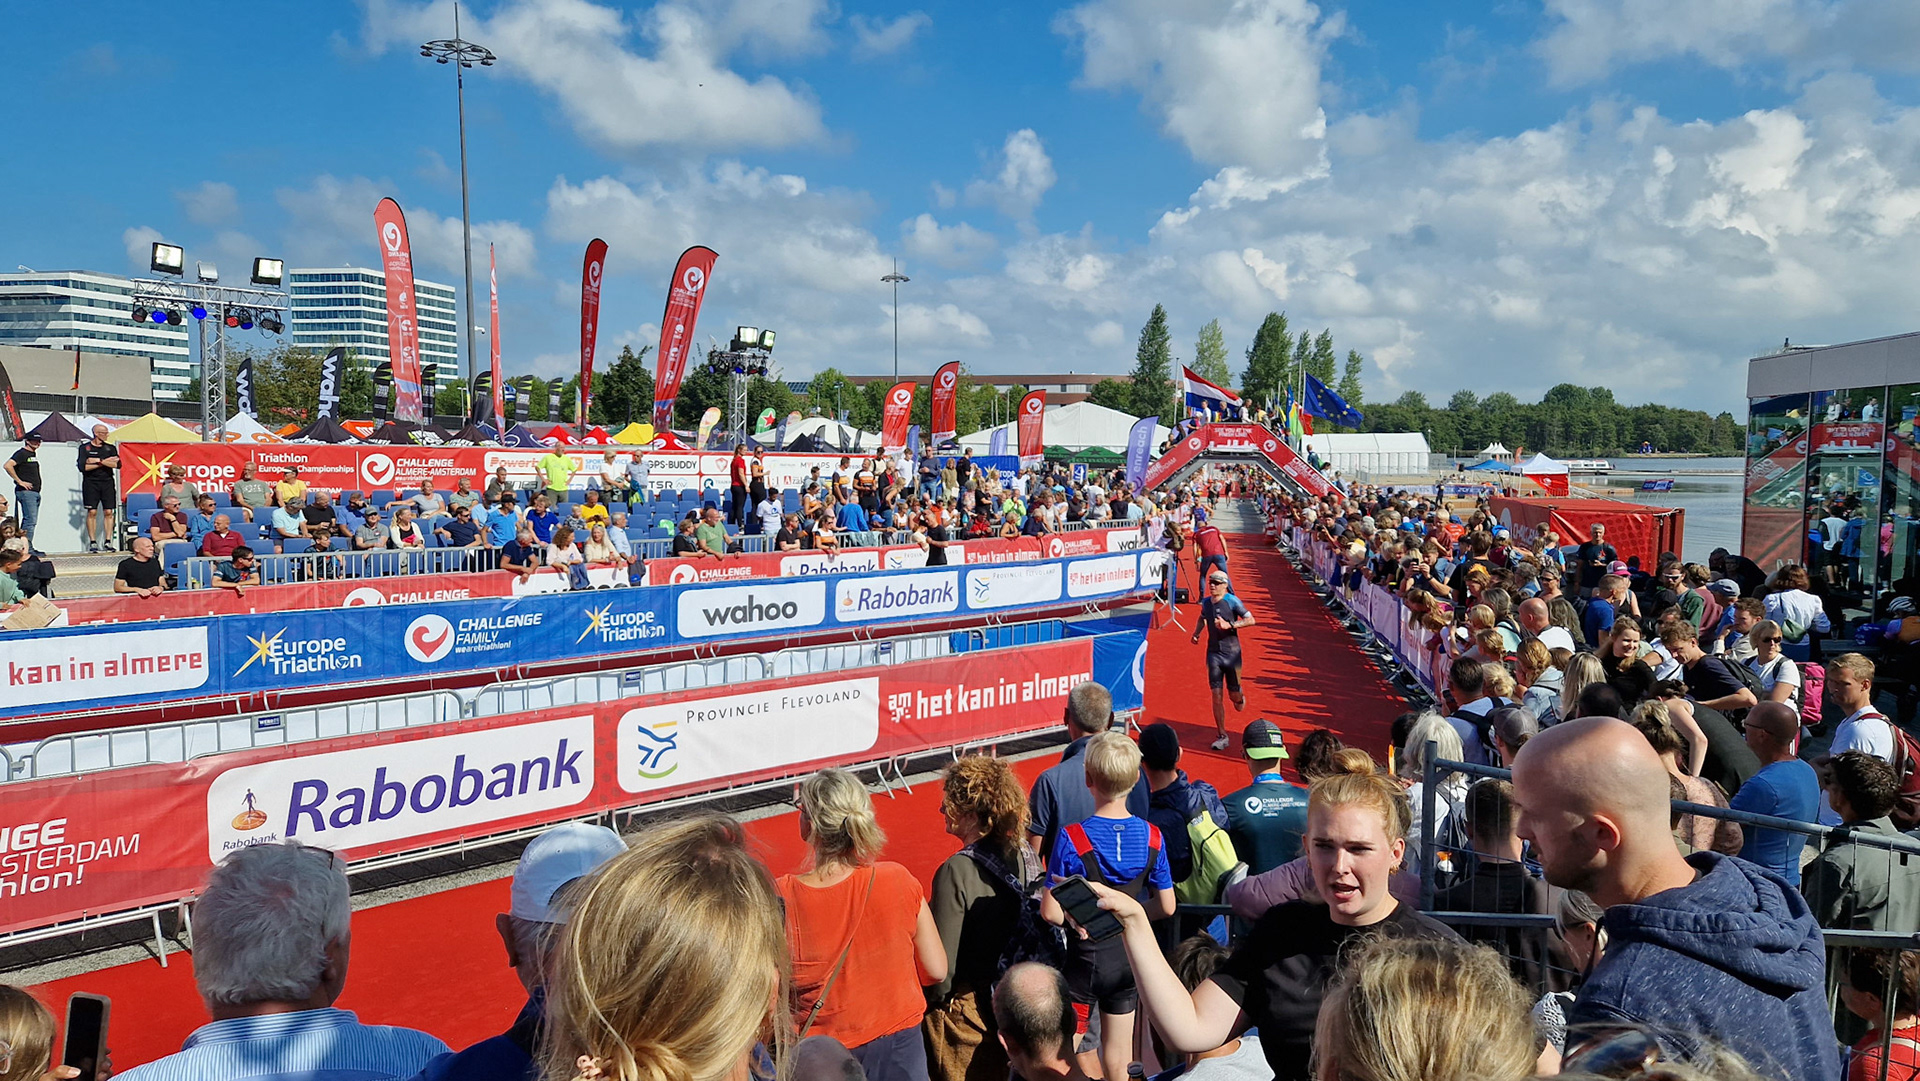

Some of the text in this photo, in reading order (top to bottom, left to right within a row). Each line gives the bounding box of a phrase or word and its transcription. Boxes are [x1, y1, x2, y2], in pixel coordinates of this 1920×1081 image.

[258, 453, 308, 463] Triathlon
[1133, 426, 1148, 473] enreach
[160, 462, 235, 479] Erope
[297, 465, 354, 474] Championships
[395, 468, 477, 476] ALMERE-AMSTERDAM
[396, 459, 454, 467] CHALLENGE
[648, 460, 697, 469] GPS-BUDDY
[700, 566, 752, 578] CHALLENGE
[1079, 572, 1093, 585] het
[1094, 570, 1106, 583] kan
[390, 589, 470, 604] CHALLENGE
[857, 580, 954, 611] Rabobank
[601, 610, 655, 628] Europe
[702, 594, 798, 627] wahoo
[458, 612, 543, 632] CHALLENGE
[455, 630, 499, 646] FAMILY
[600, 624, 665, 643] Triathlon
[269, 636, 346, 656] Europe
[8, 652, 202, 686] kan in almere
[268, 651, 362, 675] Triathlon
[686, 688, 861, 724] PROVINCIE FLEVOLAND
[916, 688, 953, 720] het
[957, 684, 995, 713] kan
[999, 678, 1016, 705] in
[284, 738, 584, 837] Rabobank
[222, 832, 278, 851] Rabobank
